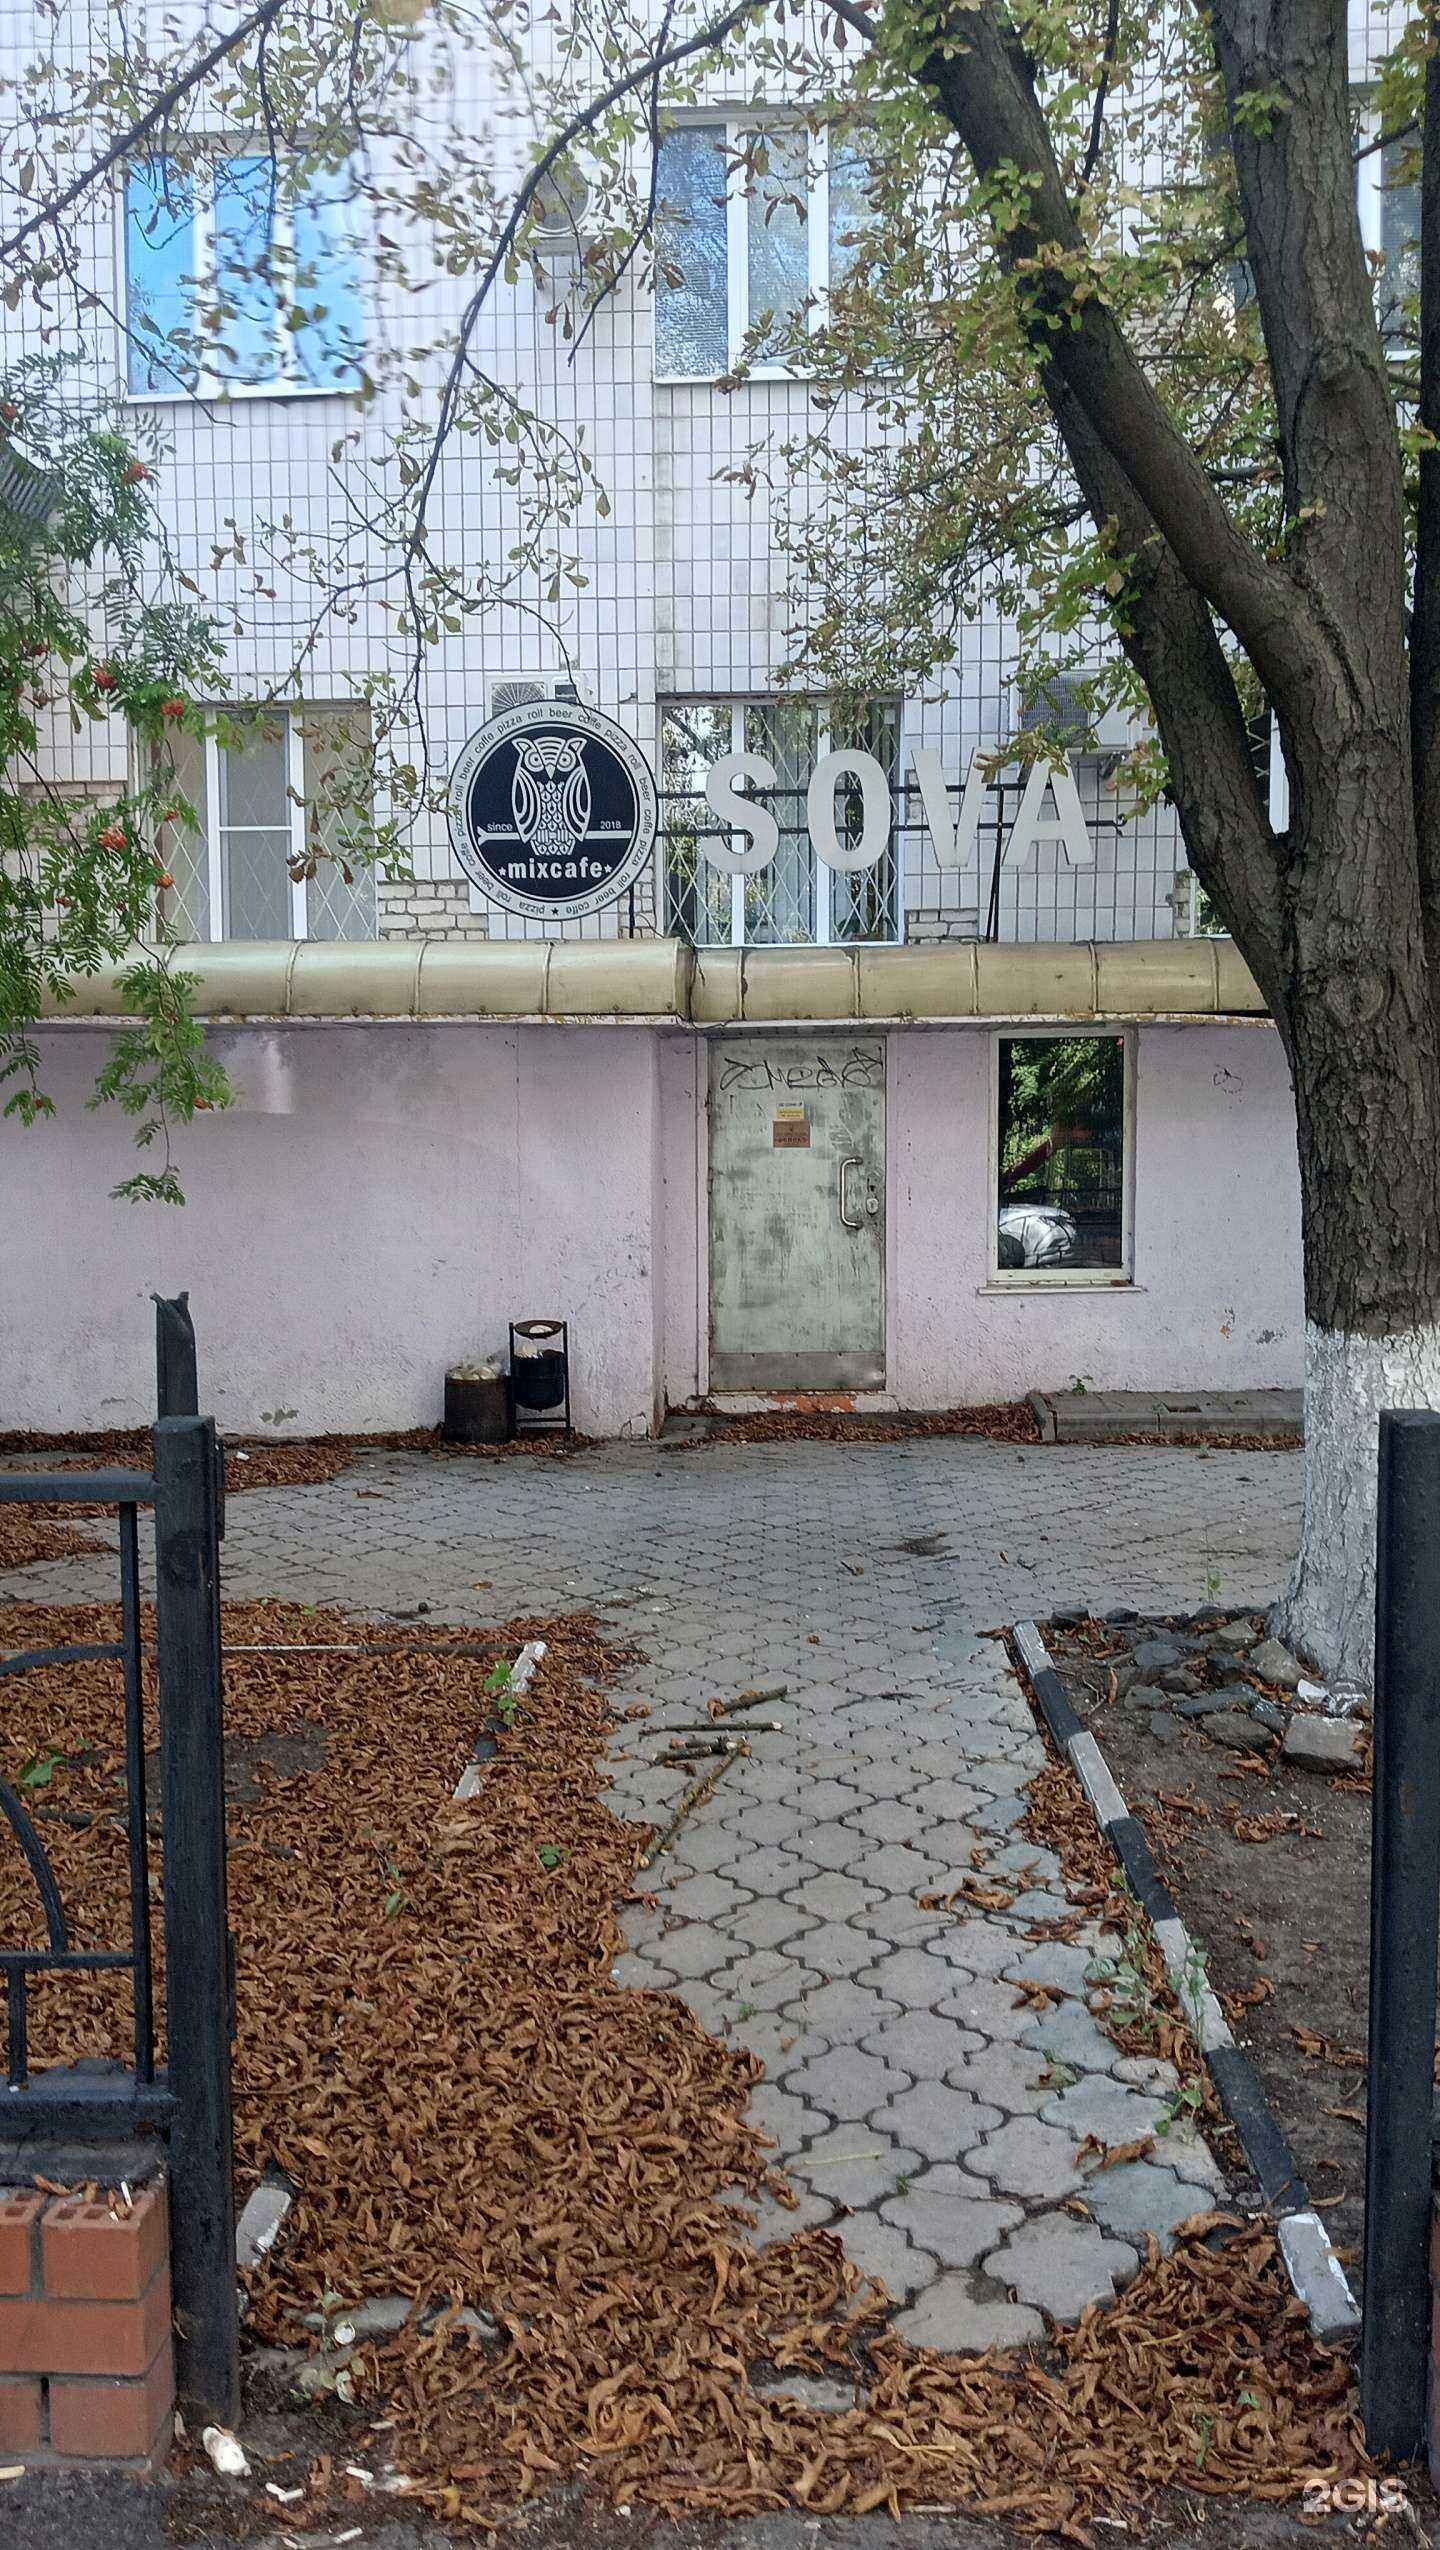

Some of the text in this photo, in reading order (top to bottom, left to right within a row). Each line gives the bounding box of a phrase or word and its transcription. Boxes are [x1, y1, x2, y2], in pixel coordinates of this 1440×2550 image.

[528, 708, 543, 720] roll
[549, 708, 572, 718] beer
[498, 715, 522, 735] pizza
[604, 729, 628, 752] pizza
[455, 785, 463, 801] roll
[640, 777, 651, 801] beer
[702, 747, 1093, 875] SOVA
[487, 821, 513, 831] since
[600, 821, 621, 829] 2018
[632, 840, 648, 866] pizza
[508, 857, 602, 878] mixcafe
[617, 872, 630, 888] roll
